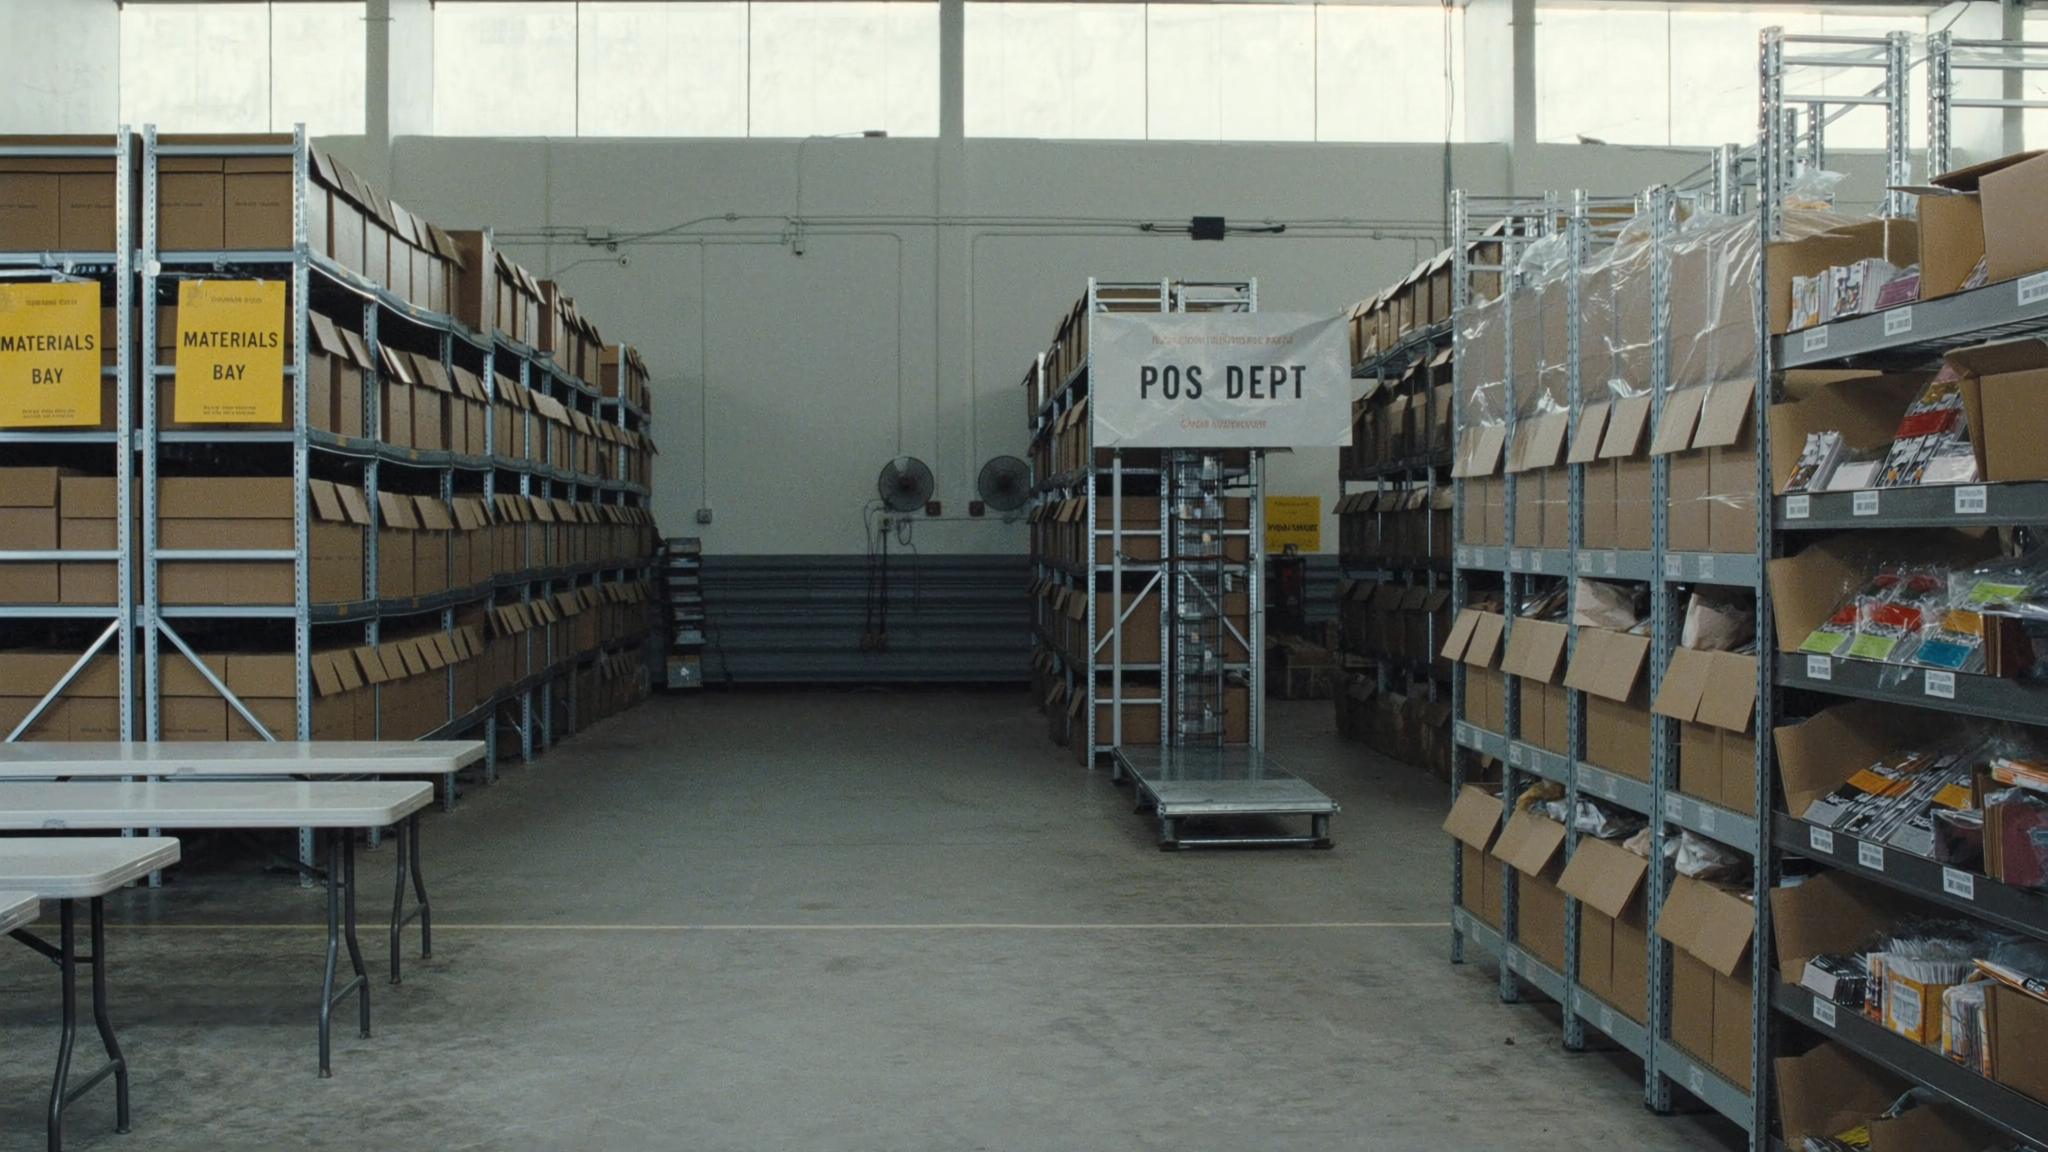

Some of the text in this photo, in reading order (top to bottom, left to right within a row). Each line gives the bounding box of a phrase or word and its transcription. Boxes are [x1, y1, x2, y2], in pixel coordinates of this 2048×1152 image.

[1, 334, 94, 352] MATERIALS
[184, 331, 278, 348] MATERIALS
[32, 368, 63, 384] BAY
[213, 364, 246, 380] BAY
[1140, 365, 1306, 400] POS DEPT
